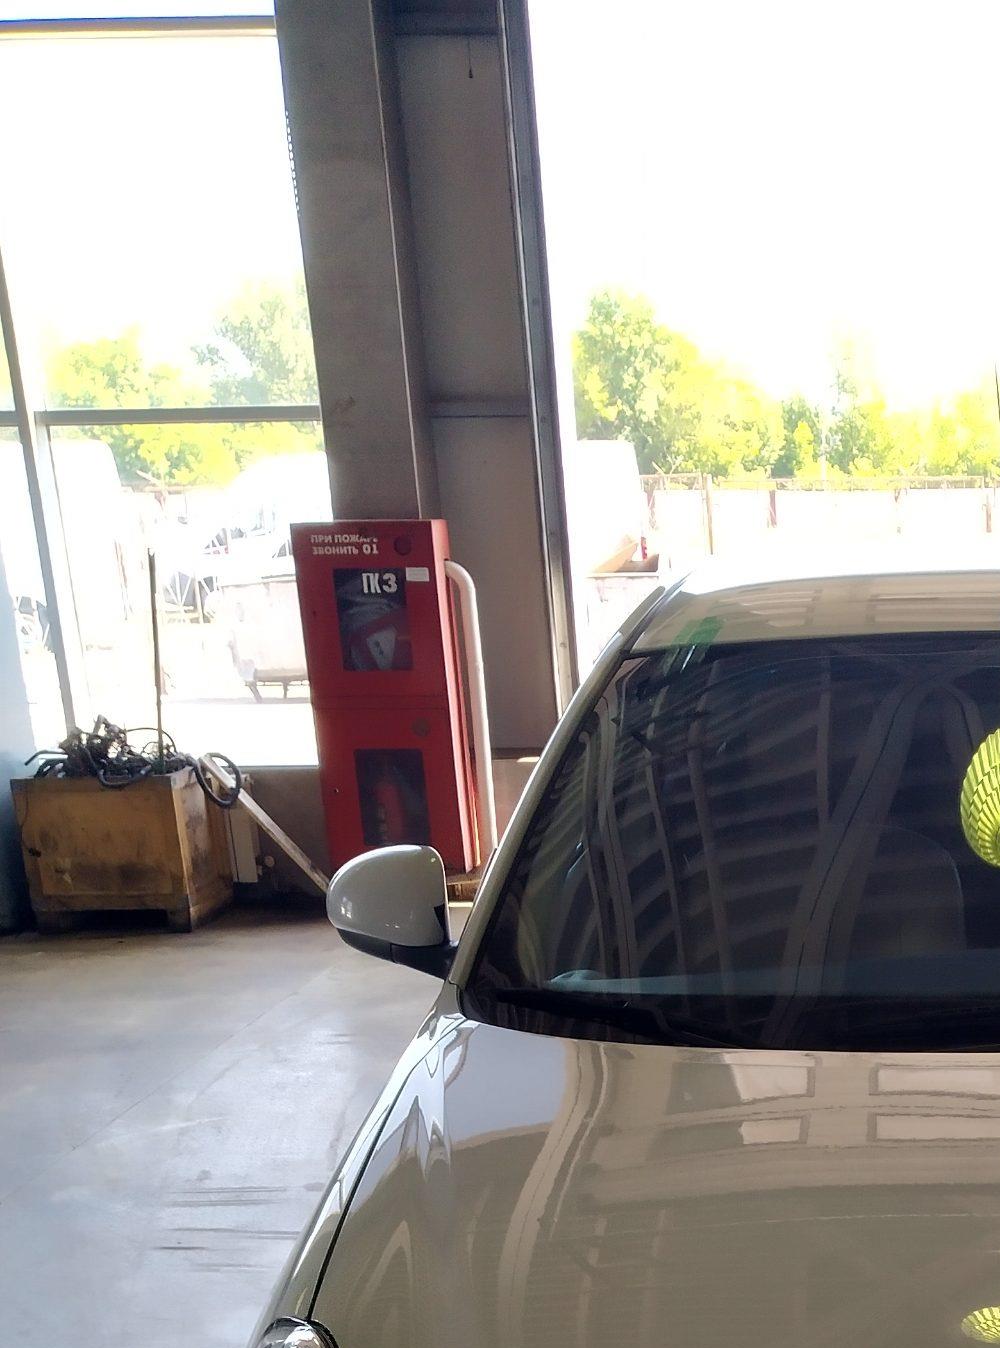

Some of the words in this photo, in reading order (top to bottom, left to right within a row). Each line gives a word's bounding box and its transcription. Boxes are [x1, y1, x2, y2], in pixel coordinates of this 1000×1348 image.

[310, 534, 333, 544] ПРИ
[312, 546, 359, 555] ЗВОНИТЬ
[362, 544, 379, 554] 01
